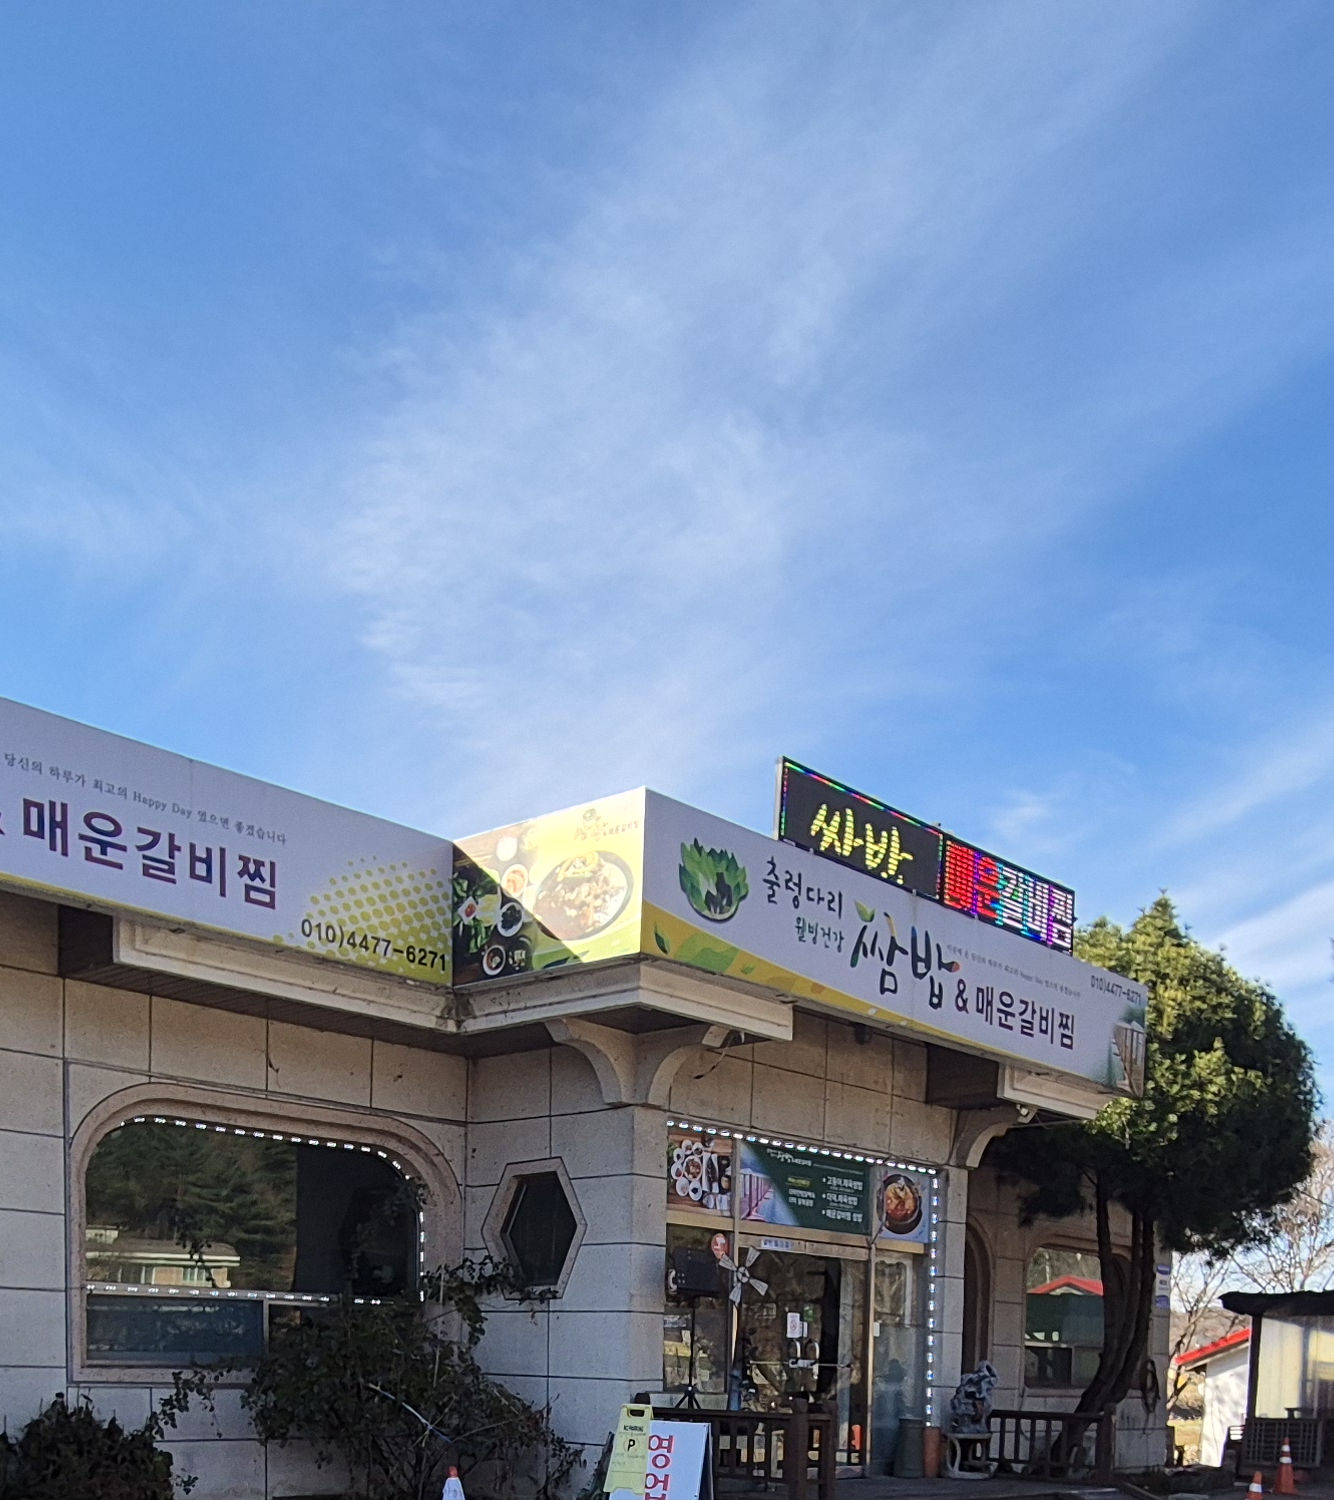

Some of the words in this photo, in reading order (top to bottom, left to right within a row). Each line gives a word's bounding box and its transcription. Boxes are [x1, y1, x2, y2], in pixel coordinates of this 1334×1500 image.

[4, 752, 43, 775] 당신의
[49, 765, 87, 788] 하루가
[92, 779, 128, 801] 최고의
[133, 791, 168, 812] Happy
[172, 803, 193, 819] Day
[22, 797, 277, 911] 매운갈비찜
[762, 856, 843, 919] 출렁다리
[301, 919, 446, 971] 010)4477-6271
[794, 916, 844, 953] 웰빙건강
[850, 911, 960, 1010] 쌈밥
[955, 978, 970, 1014] &
[975, 985, 1075, 1050] 매운갈비찜
[1090, 974, 1142, 1006] 010)4477-6271
